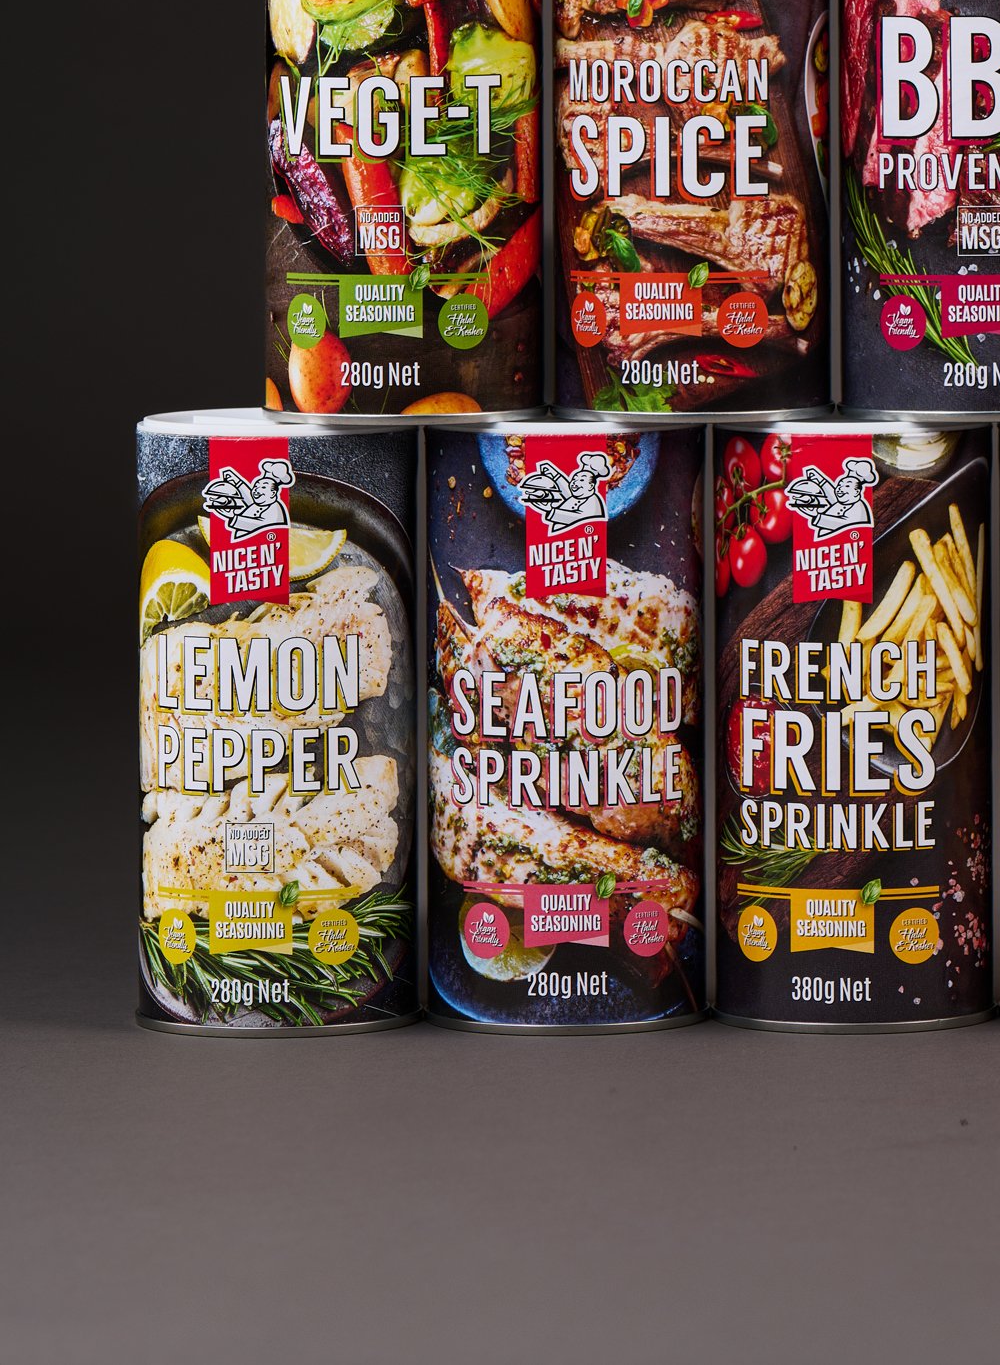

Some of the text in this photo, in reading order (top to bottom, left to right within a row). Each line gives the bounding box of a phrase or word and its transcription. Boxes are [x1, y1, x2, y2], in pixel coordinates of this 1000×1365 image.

[569, 59, 769, 102] MOROCCAN
[280, 75, 502, 157] VEGE-T
[571, 114, 769, 197] SPICE
[360, 212, 399, 223] NO ADDED
[962, 212, 972, 223] NO
[360, 226, 400, 249] MSG
[355, 285, 405, 302] QUALITY
[634, 283, 683, 300] QUALITY
[346, 305, 415, 322] SEASONING
[626, 303, 693, 320] SEASONING
[341, 362, 420, 388] 280g Net
[622, 360, 699, 387] 280g Net
[944, 362, 988, 389] 280g
[529, 536, 598, 566] NICE N'
[542, 557, 601, 587] TASTY
[158, 634, 359, 712] LEMON
[742, 639, 936, 701] FRENCH
[452, 667, 683, 737] SEAFOOD
[158, 725, 361, 792] PEPPER
[742, 707, 936, 792] FRIES
[452, 744, 683, 807] SPRINKLE
[741, 799, 936, 849] SPRINKLE
[225, 902, 275, 919] QUALITY
[541, 894, 591, 912] QUALITY
[806, 899, 855, 917] QUALITY
[216, 922, 285, 939] SEASONING
[531, 915, 601, 932] SEASONING
[797, 920, 866, 937] SEASONING
[211, 979, 290, 1006] 280g Net
[527, 971, 608, 999] 280g Net
[792, 976, 871, 1004] 380g Net
